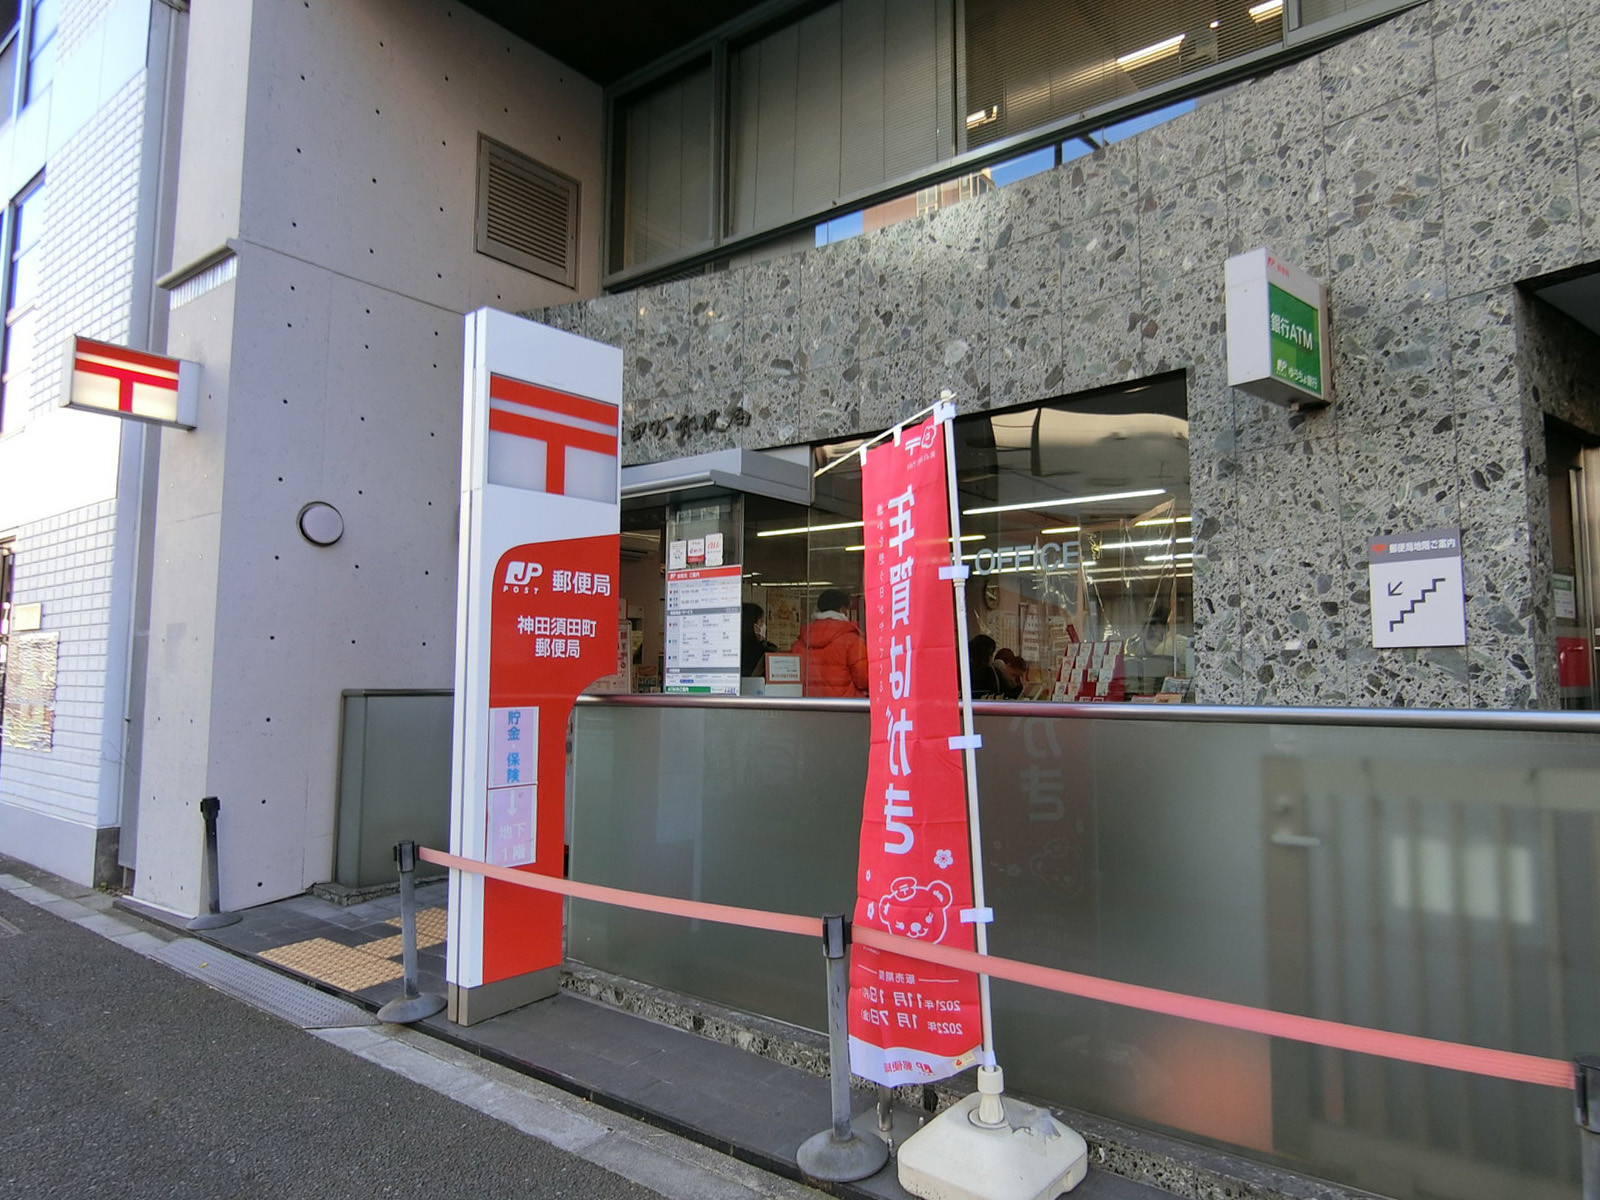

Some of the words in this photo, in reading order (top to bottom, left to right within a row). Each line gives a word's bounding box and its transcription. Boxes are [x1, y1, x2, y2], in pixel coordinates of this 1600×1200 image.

[1270, 312, 1313, 350] 銀行ATM
[973, 541, 1081, 576] OFFICE
[503, 586, 539, 594] POST
[552, 570, 611, 597] 郵便局
[517, 615, 597, 637] 神田須田町
[535, 638, 581, 658] 郵便局
[499, 823, 526, 839] 地下
